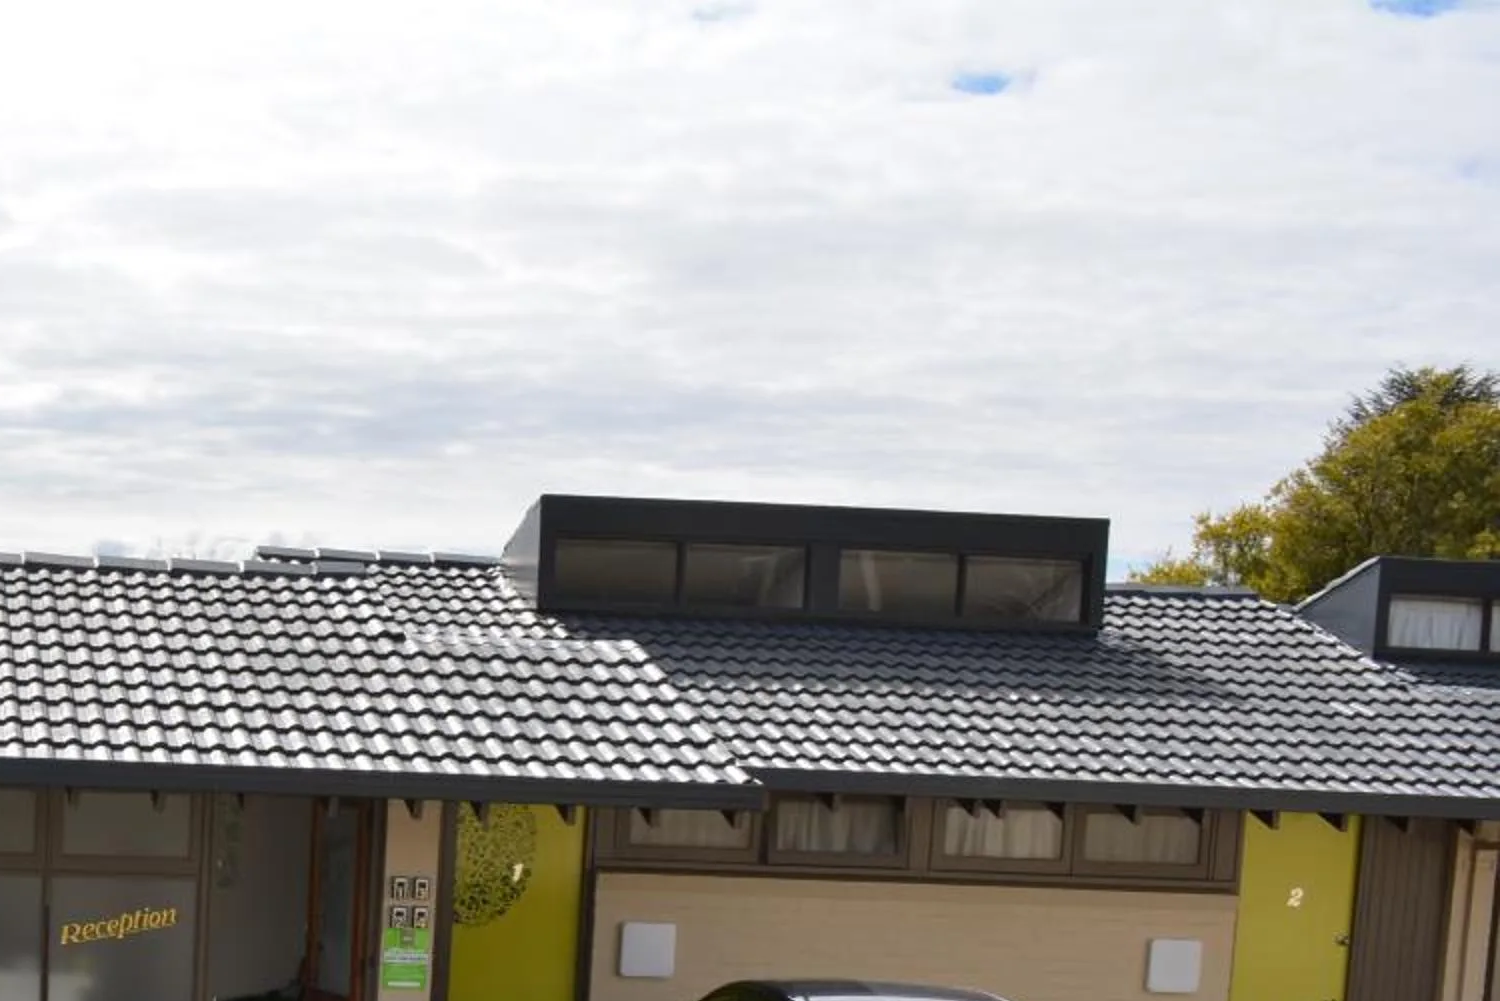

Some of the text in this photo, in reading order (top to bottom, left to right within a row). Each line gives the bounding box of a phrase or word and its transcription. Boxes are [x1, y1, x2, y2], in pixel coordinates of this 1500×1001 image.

[512, 863, 524, 884] 1
[1286, 887, 1304, 908] 2
[60, 906, 177, 945] Reception
